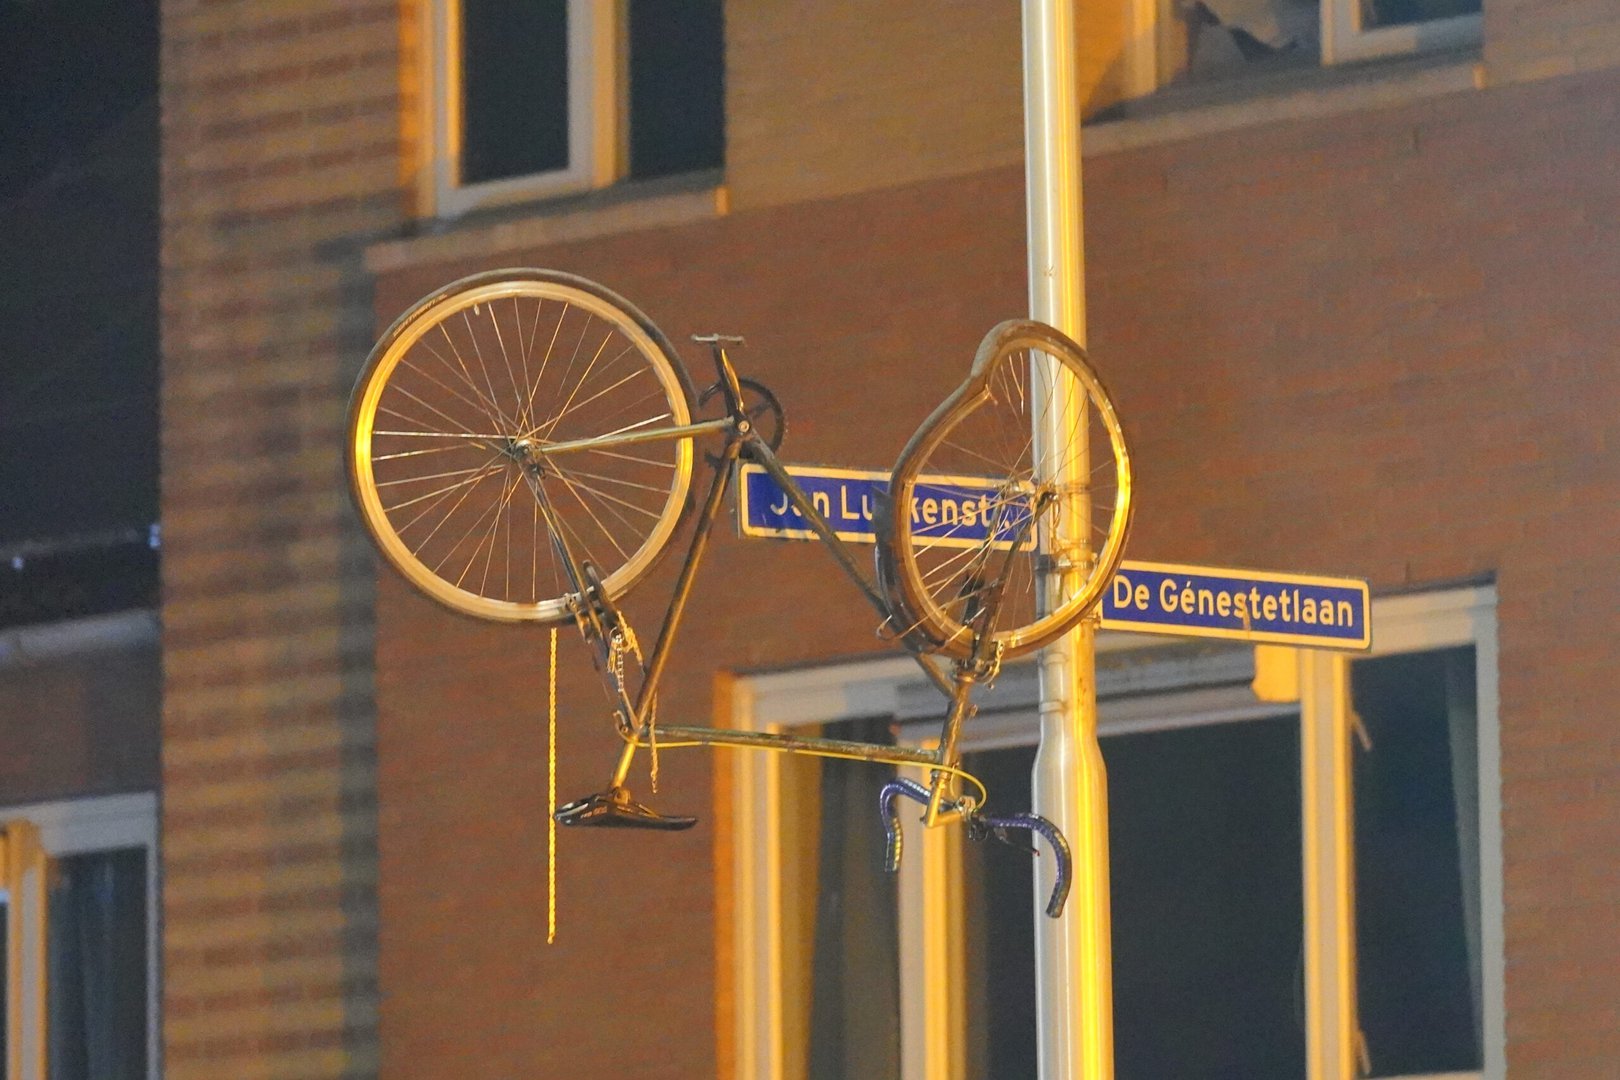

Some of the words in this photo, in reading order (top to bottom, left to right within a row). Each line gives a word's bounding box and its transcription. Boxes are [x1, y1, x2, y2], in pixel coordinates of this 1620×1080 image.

[770, 491, 830, 519] Jn
[841, 484, 1010, 528] Lukenst.
[1113, 574, 1150, 611] De
[1159, 578, 1353, 628] Génestetlaan
